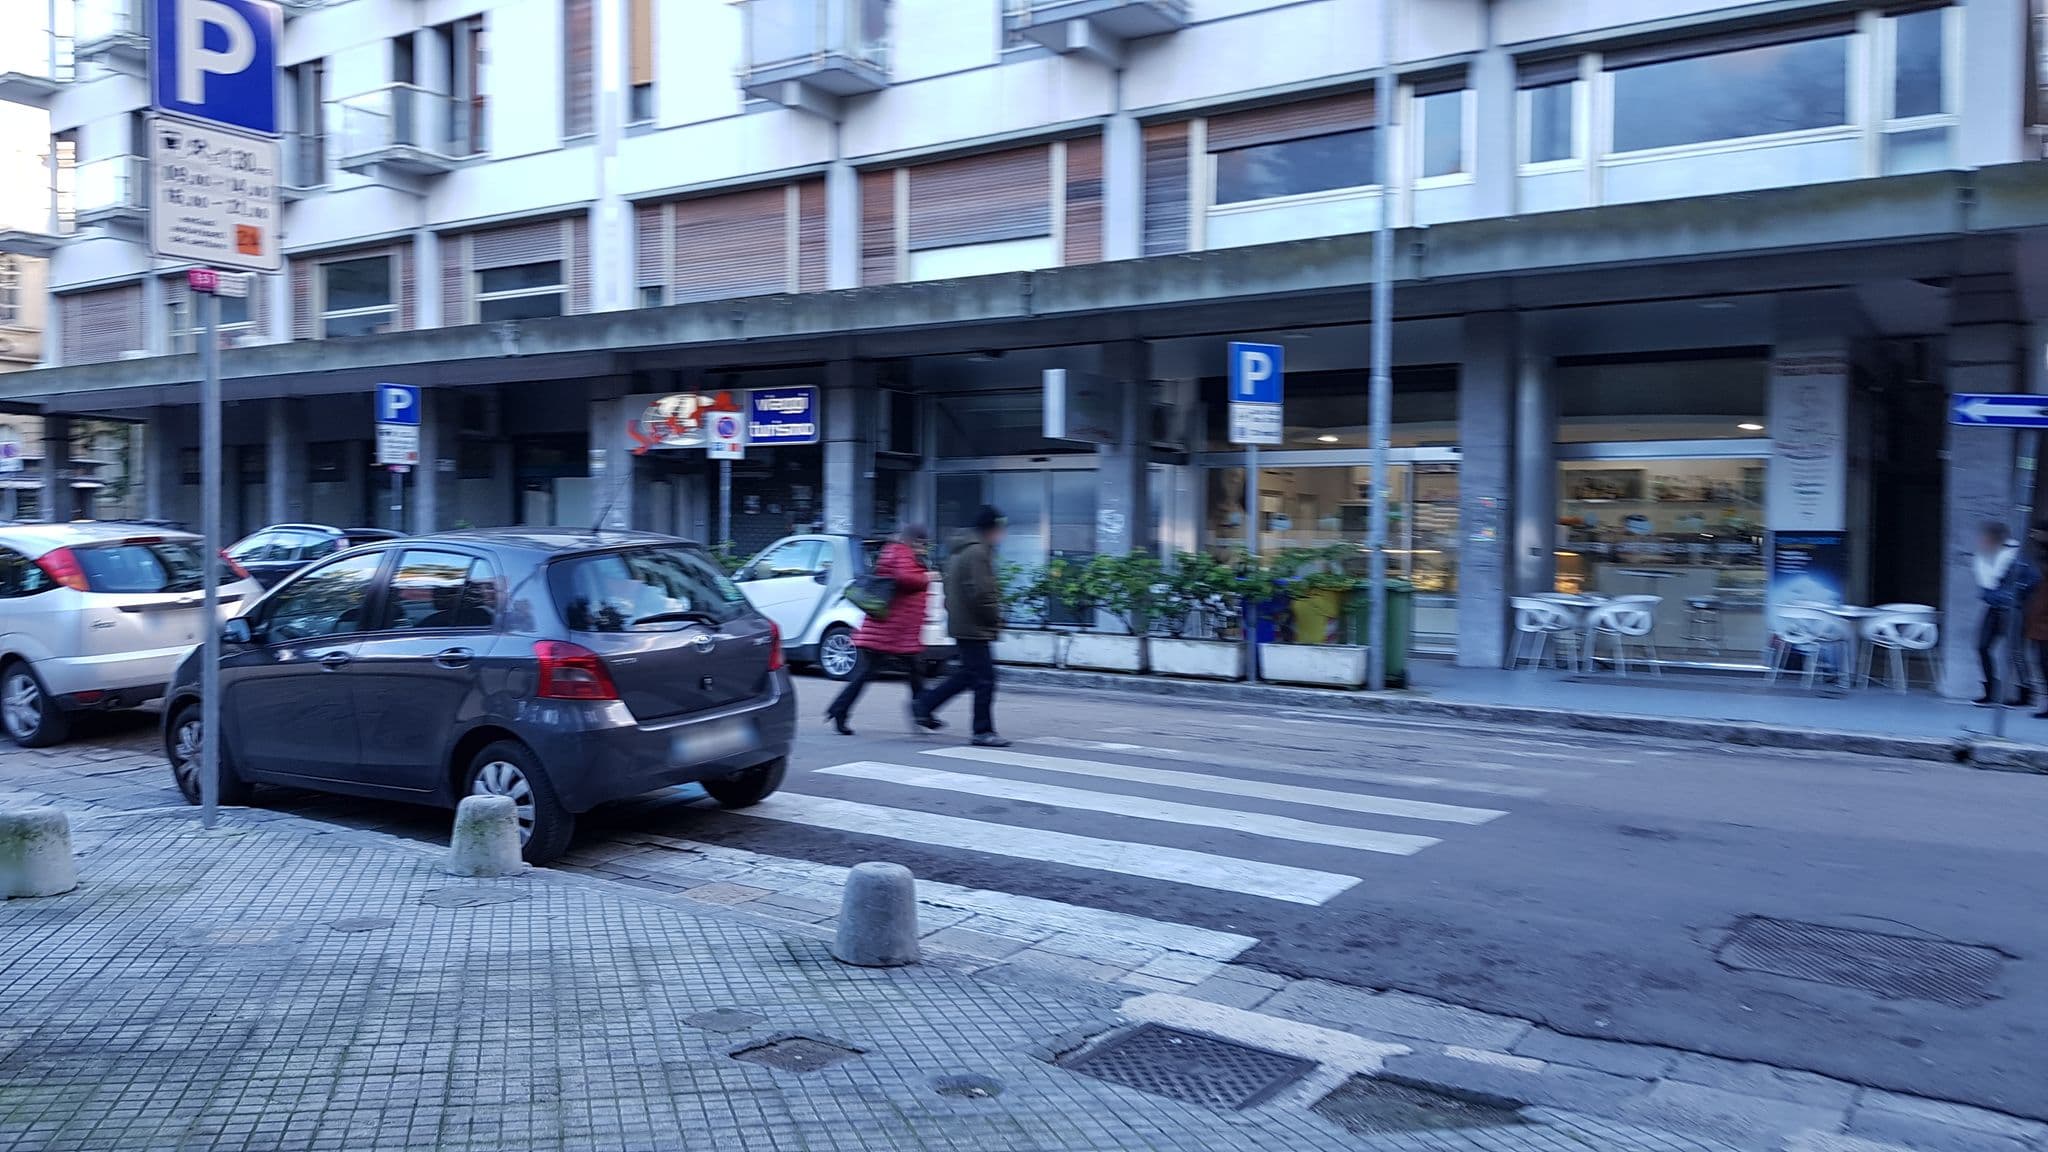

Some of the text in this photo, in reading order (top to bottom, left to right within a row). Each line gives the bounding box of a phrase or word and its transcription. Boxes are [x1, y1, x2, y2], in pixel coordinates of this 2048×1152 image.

[175, 0, 257, 105] P
[1239, 350, 1273, 396] P
[383, 387, 413, 419] P
[754, 393, 809, 415] viaggi
[748, 421, 816, 437] turismo
